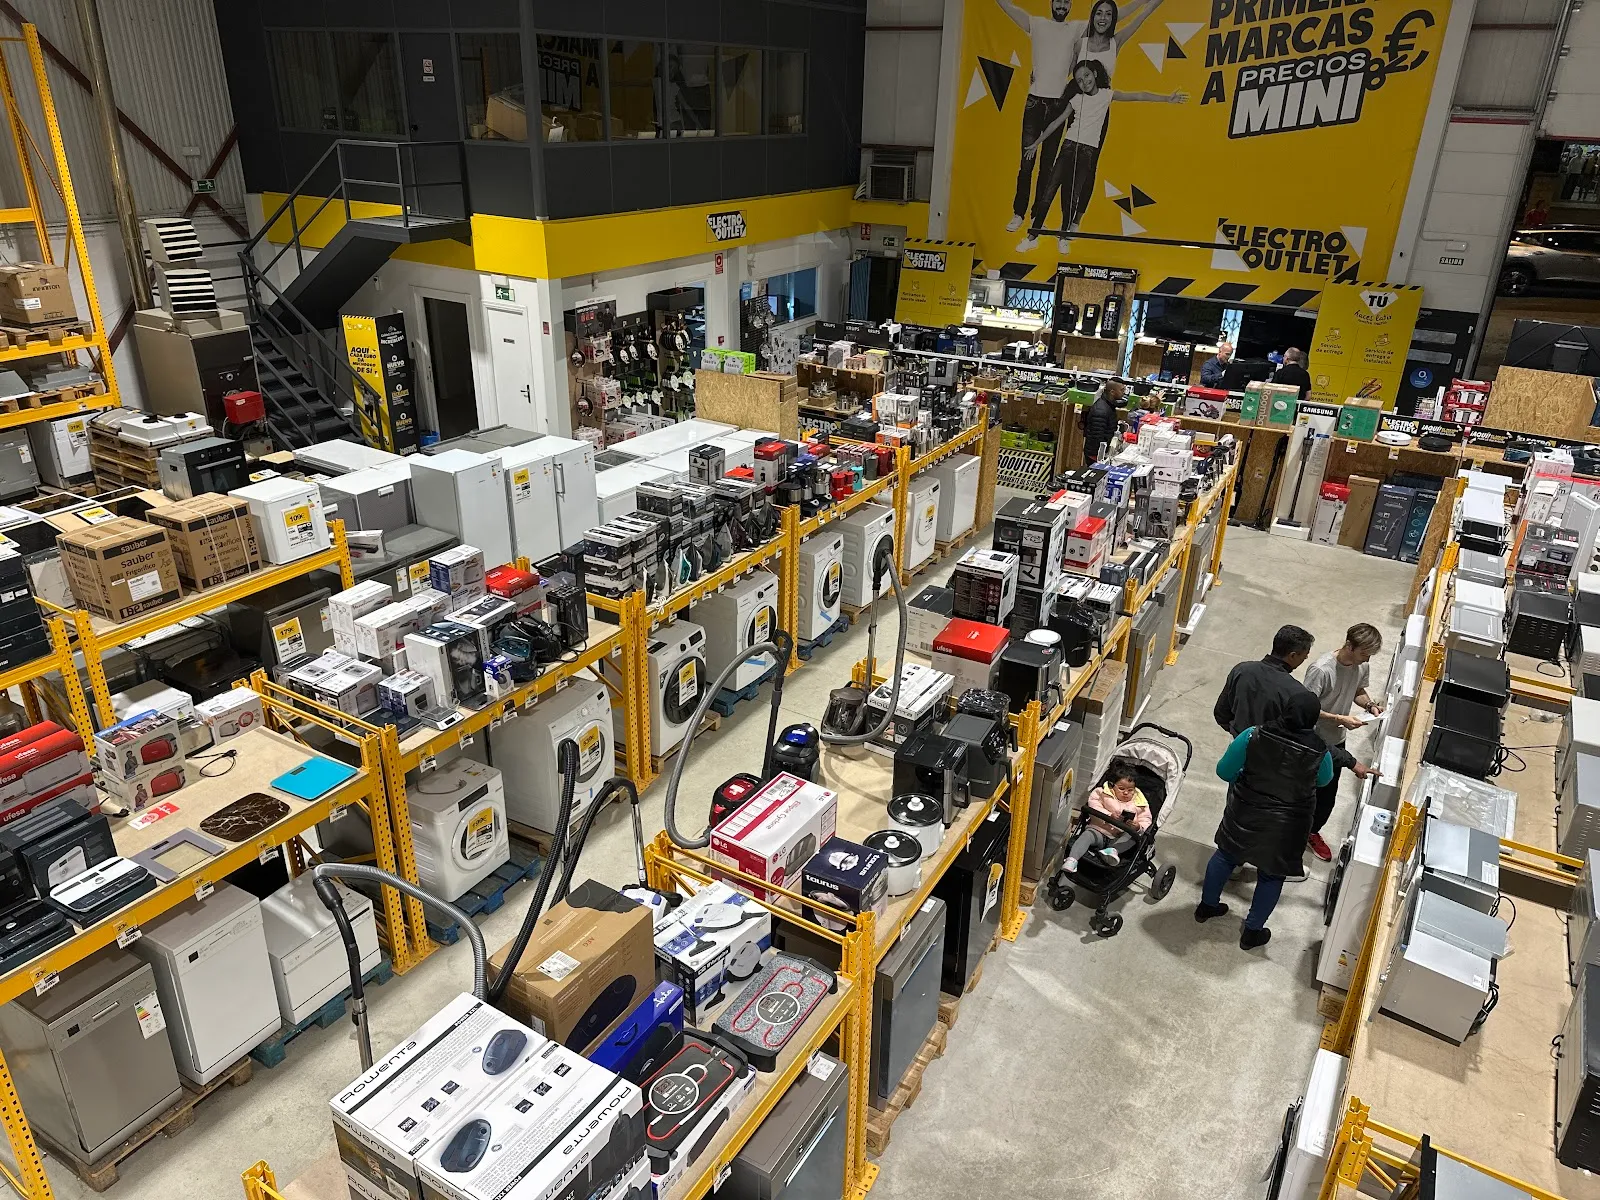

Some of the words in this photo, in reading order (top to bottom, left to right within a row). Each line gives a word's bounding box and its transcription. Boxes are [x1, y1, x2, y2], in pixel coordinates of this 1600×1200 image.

[1205, 8, 1374, 67] MARCAS
[1240, 52, 1367, 88] PRECIOS
[1200, 71, 1226, 105] A
[1232, 73, 1364, 135] MINI
[708, 214, 743, 229] ELECTRO
[715, 224, 744, 240] OUTLET
[1219, 221, 1347, 254] ELECTRO
[906, 251, 941, 262] ELECTRO
[1241, 247, 1351, 276] OUTLET
[1440, 258, 1463, 266] SALIDA
[911, 259, 942, 270] OUTLET
[1368, 292, 1389, 308] TÚ
[1257, 389, 1272, 426] Roomba
[1302, 406, 1334, 416] SAMSUNG
[797, 416, 837, 431] ELECTRO
[1385, 417, 1415, 428] ELECTRO
[1389, 424, 1417, 434] OUTLET
[998, 455, 1045, 475] OOUTLET
[1025, 478, 1045, 489] STOCKS
[120, 538, 148, 553] sauber
[120, 550, 155, 569] sauber
[0, 773, 17, 785] fesa
[3, 808, 26, 822] ufesa
[720, 841, 728, 849] LG
[779, 846, 787, 857] LG
[860, 853, 880, 877] taurus
[805, 873, 839, 892] taurus
[582, 936, 595, 948] AEG
[653, 987, 675, 1008] Jata
[339, 1041, 417, 1104] ROWENTA
